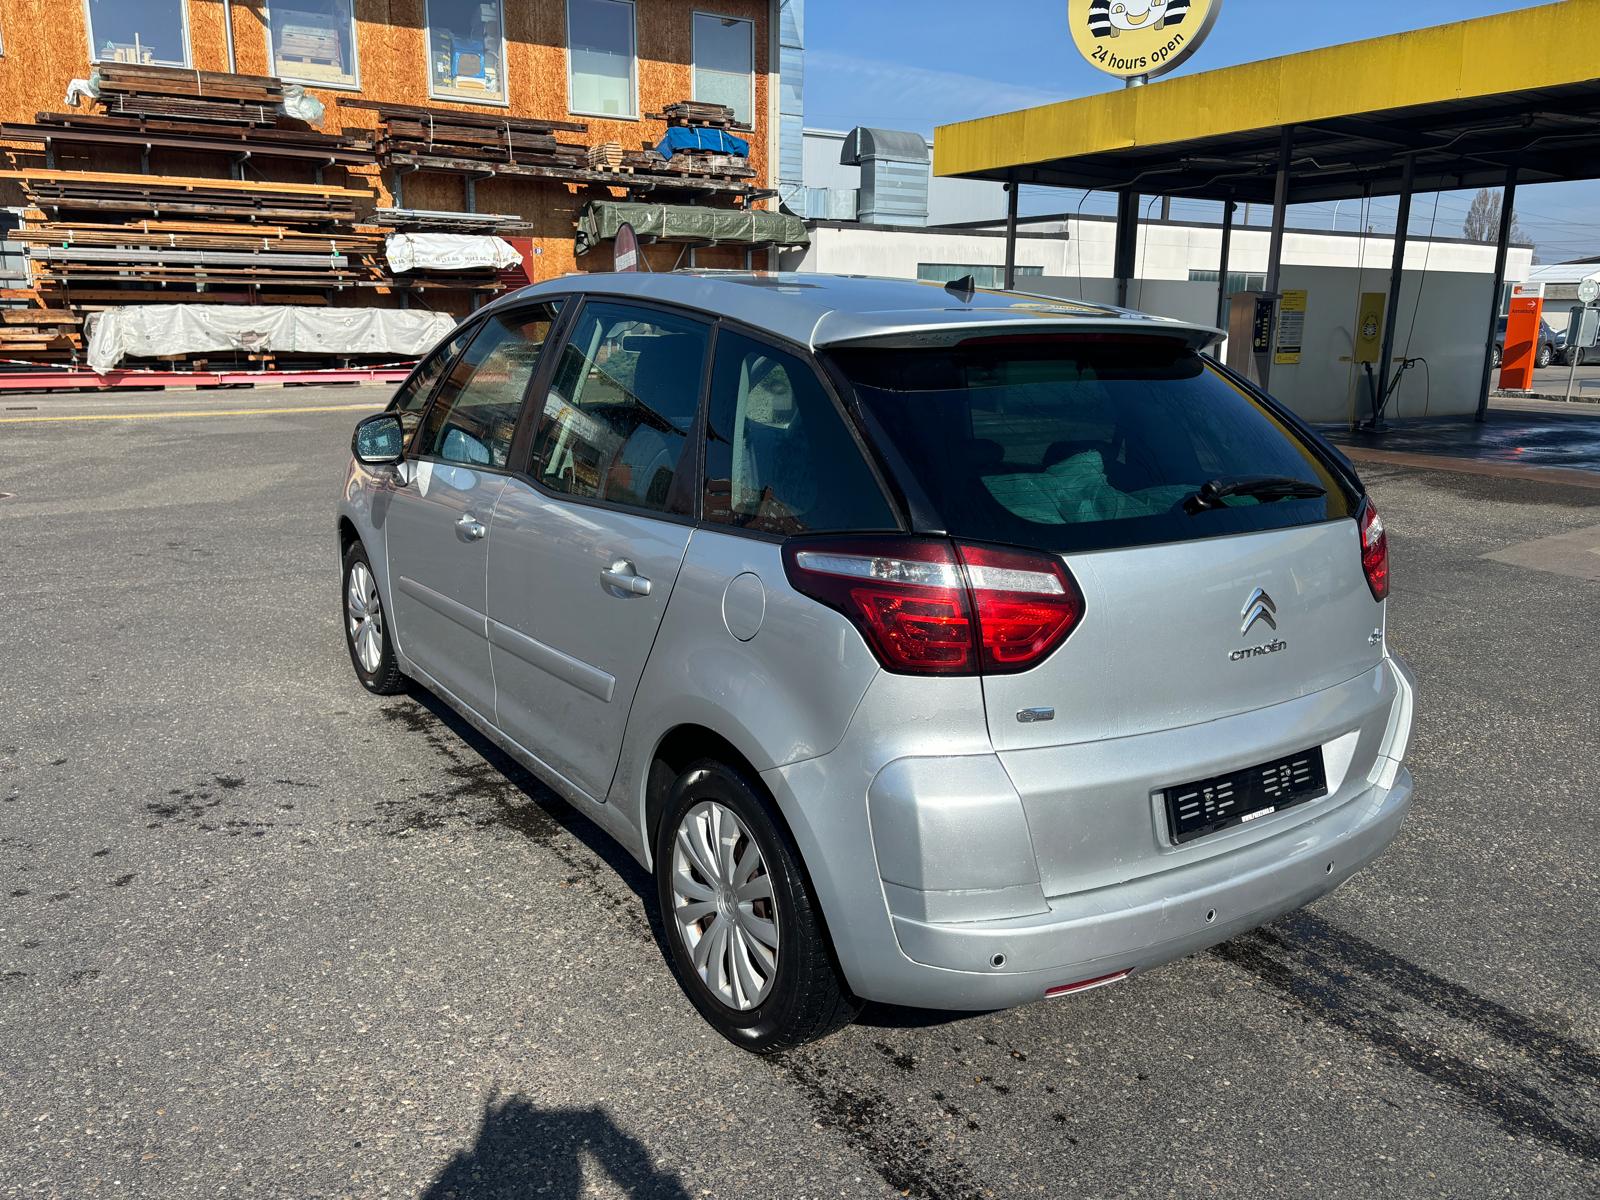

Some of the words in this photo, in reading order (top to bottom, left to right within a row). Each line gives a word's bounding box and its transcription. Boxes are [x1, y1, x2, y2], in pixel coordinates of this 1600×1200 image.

[1091, 45, 1109, 63] 24
[1108, 53, 1147, 70] hours
[1151, 33, 1185, 63] open
